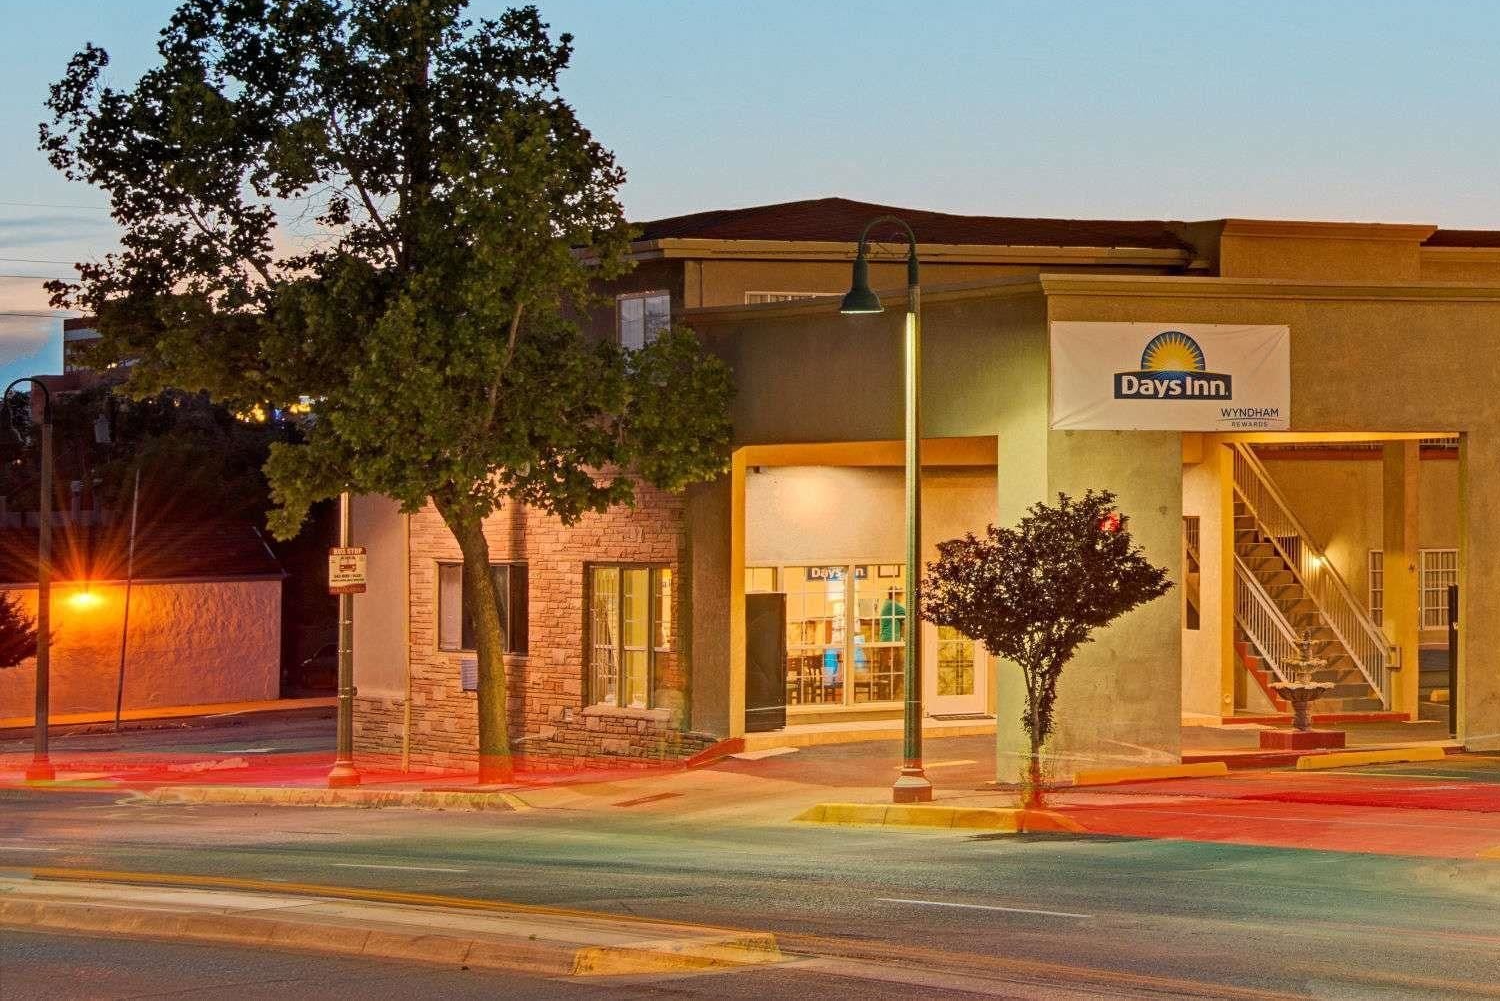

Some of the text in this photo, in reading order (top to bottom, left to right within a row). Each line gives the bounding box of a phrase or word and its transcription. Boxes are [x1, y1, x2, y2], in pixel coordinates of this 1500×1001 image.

[1121, 375, 1226, 398] Days Inn
[1221, 408, 1279, 418] WYNDHAM
